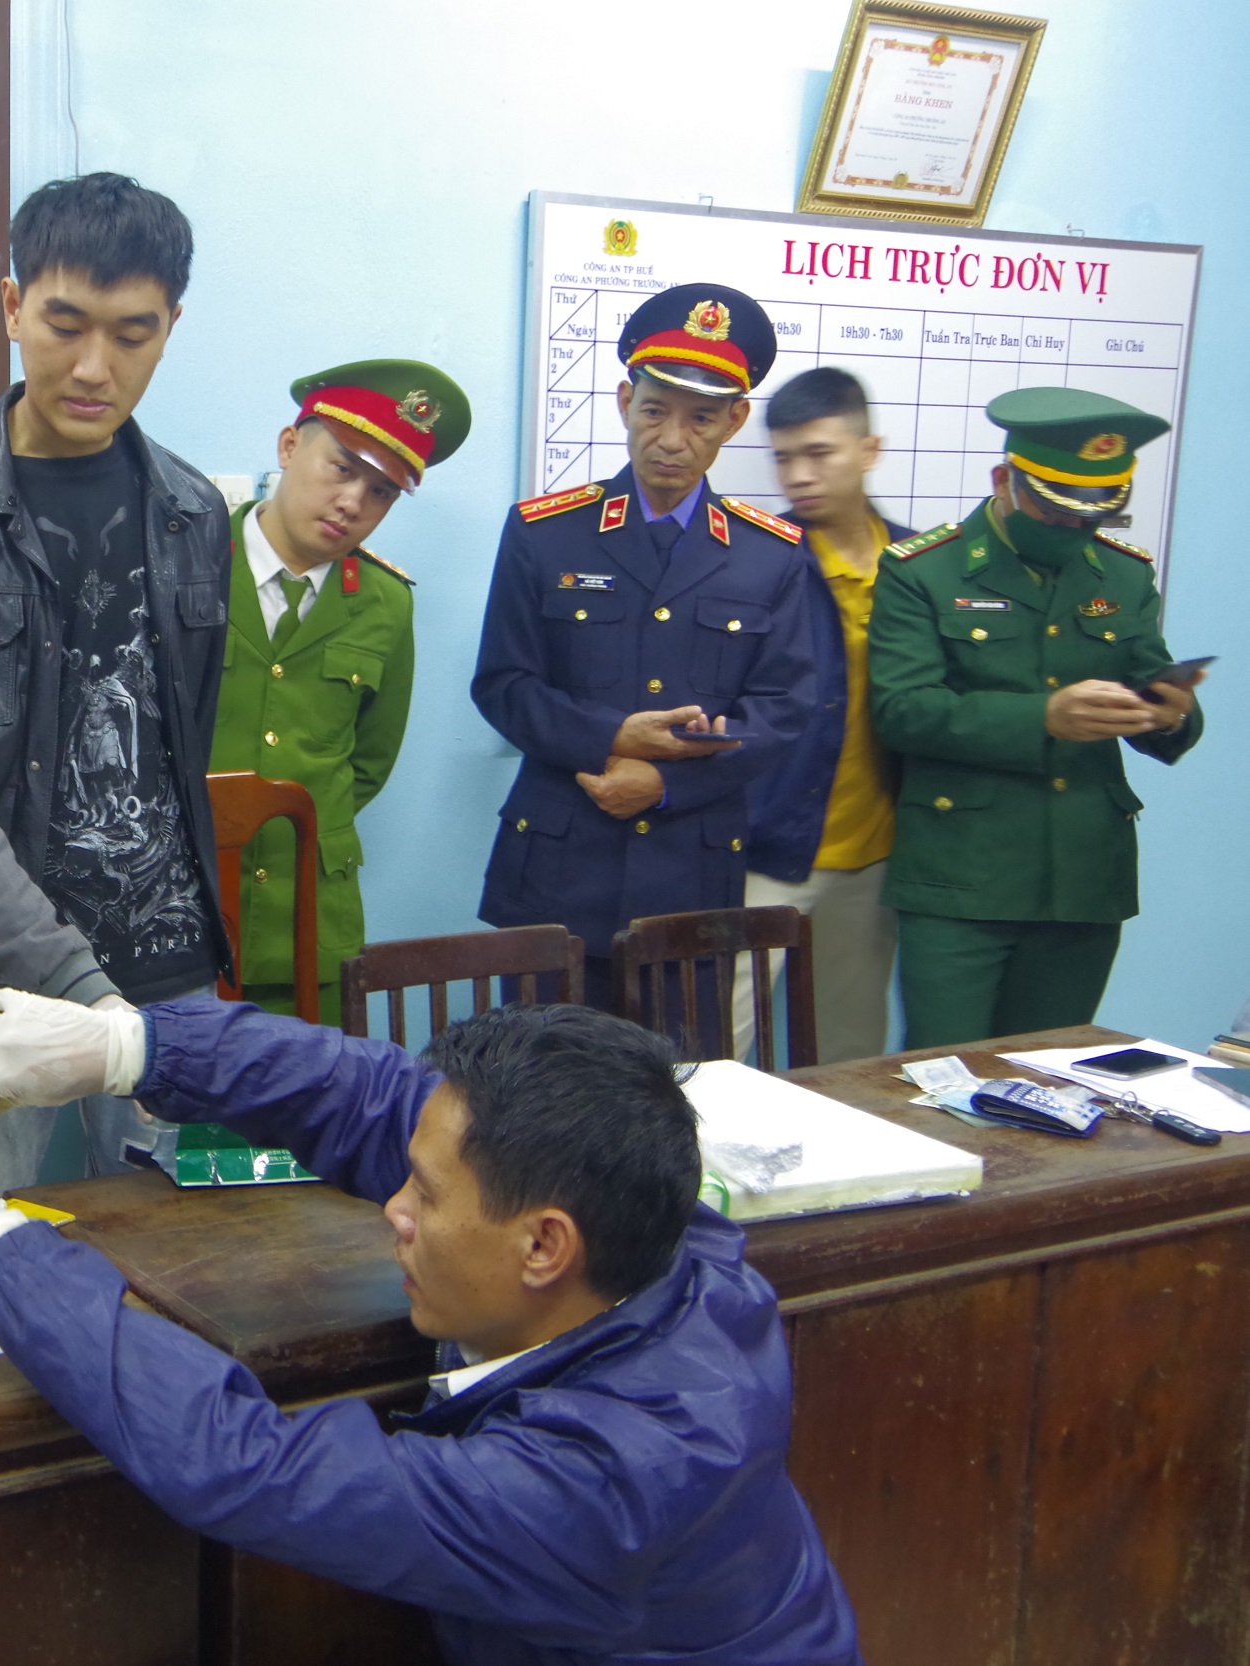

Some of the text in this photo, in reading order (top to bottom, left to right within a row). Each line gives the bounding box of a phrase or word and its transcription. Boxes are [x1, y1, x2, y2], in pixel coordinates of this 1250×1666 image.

[924, 97, 954, 109] KHEN
[583, 261, 654, 276] CÔNG AN TP HUẾ
[782, 239, 1110, 303] LỊCH TRỰC ĐƠN VỊ
[554, 273, 578, 283] CÔNG
[580, 276, 593, 284] AN
[555, 292, 578, 304] Thứ
[567, 323, 596, 338] Ngày
[840, 326, 870, 339] 19h30
[880, 328, 904, 341] 7h30
[954, 331, 971, 345] Tra
[975, 332, 1020, 349] Trực Ban
[1045, 336, 1066, 352] Huy
[1106, 338, 1123, 352] Ghi
[551, 347, 573, 359] Thứ
[551, 363, 557, 374] 2
[549, 397, 572, 409] Thứ
[549, 412, 556, 423] 3
[547, 448, 570, 460] Thứ
[547, 464, 553, 474] 4
[134, 931, 200, 958] PARIS
